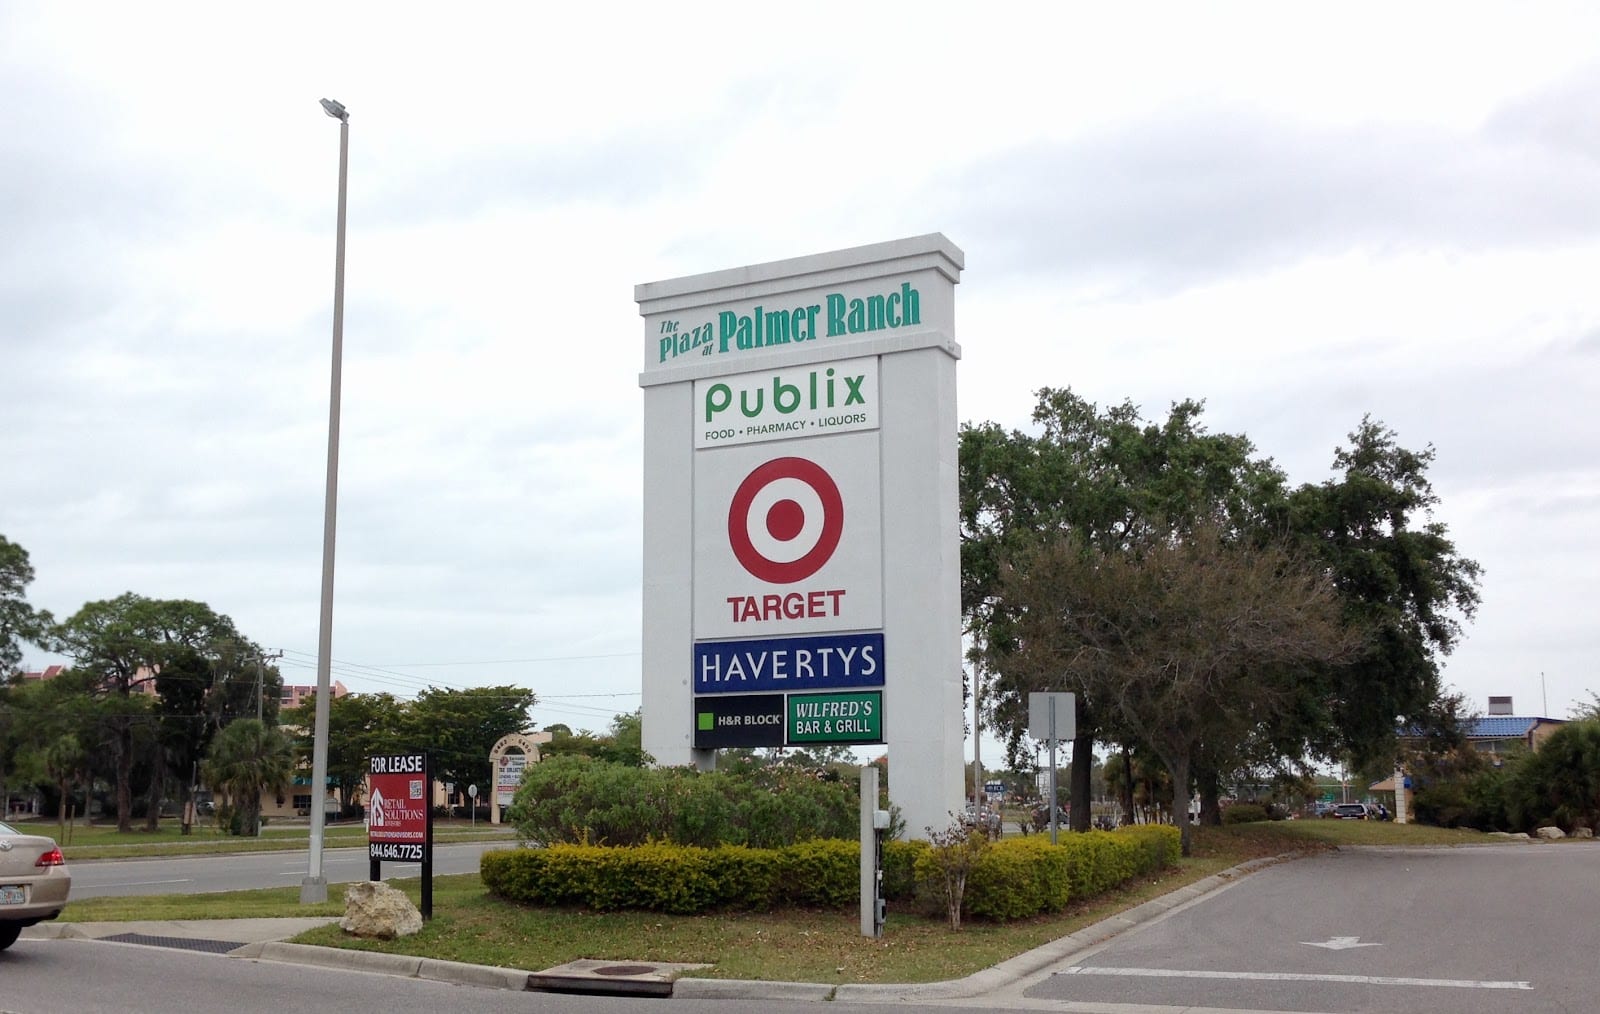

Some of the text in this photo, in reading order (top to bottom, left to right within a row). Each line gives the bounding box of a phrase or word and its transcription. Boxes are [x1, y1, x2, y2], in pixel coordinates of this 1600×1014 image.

[718, 282, 921, 353] Palmer Ranch
[660, 320, 679, 334] The
[659, 322, 713, 363] Plaza
[702, 343, 714, 356] at
[705, 368, 866, 423] Publix
[705, 413, 867, 441] FOOD PHARMACY LIQUORS
[727, 590, 846, 623] TARGET
[701, 645, 877, 683] HAVERTYS
[796, 700, 873, 718] WILFRED'S
[718, 714, 780, 726] H&R BLOCK
[796, 719, 871, 734] BAR & GRILL
[371, 755, 422, 773] FOR LEASE
[383, 798, 406, 809] RETAIL
[384, 809, 424, 820] SOLUTIONS
[370, 844, 423, 859] 844.646.7725
